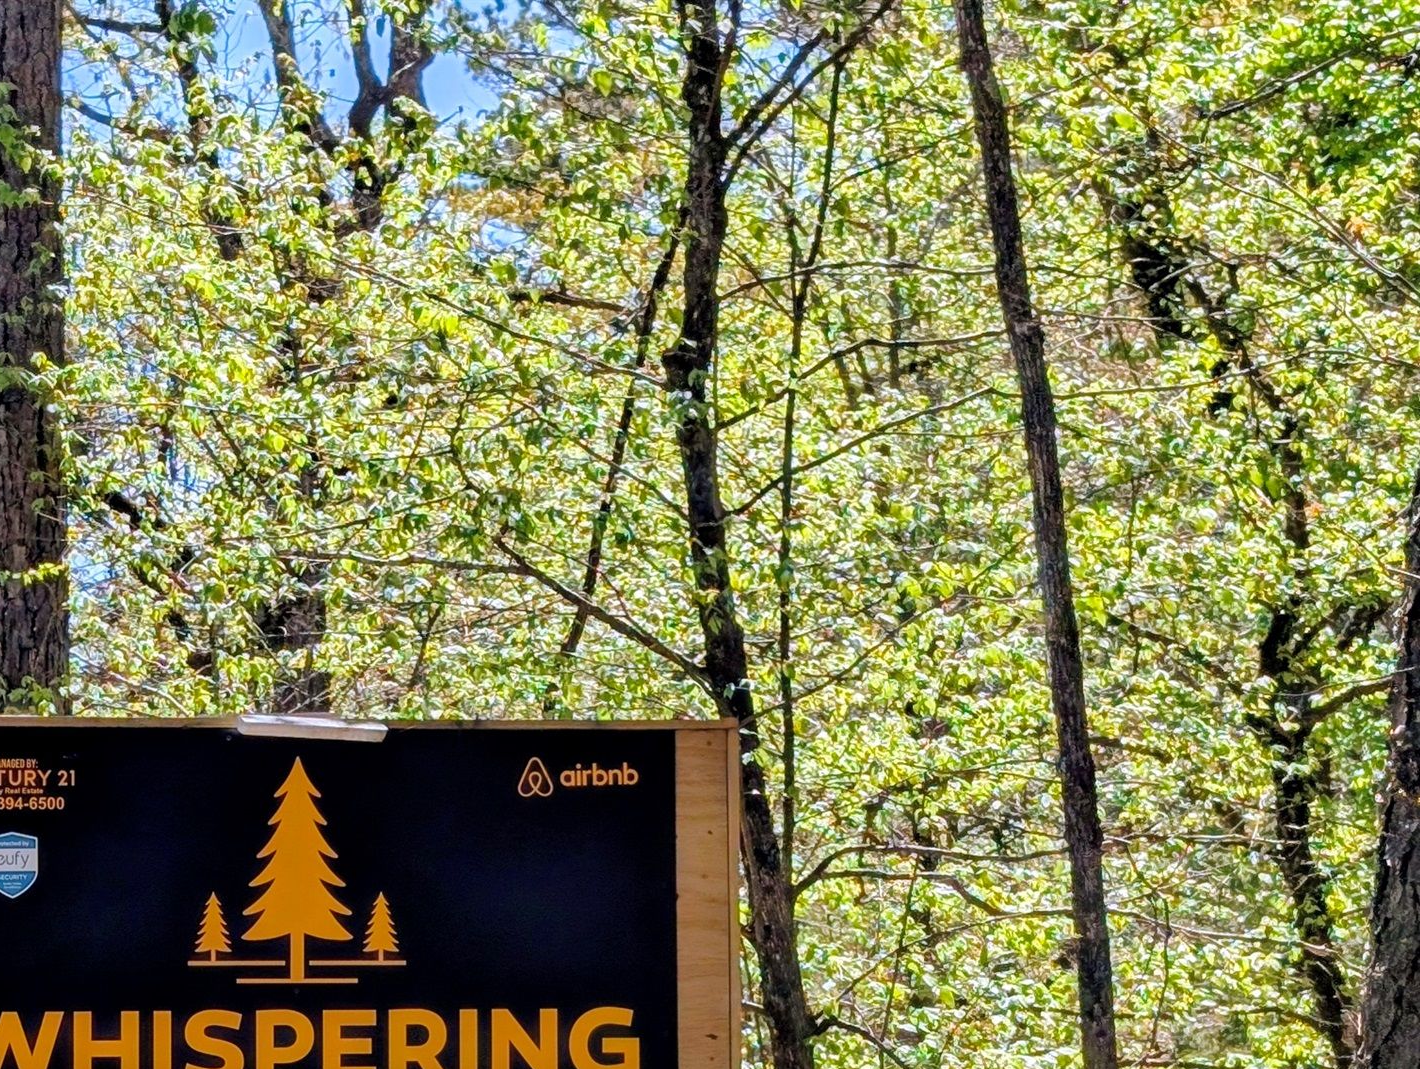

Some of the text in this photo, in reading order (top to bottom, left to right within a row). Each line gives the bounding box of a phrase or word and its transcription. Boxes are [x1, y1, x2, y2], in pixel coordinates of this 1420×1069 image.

[26, 758, 39, 769] BY:
[57, 770, 75, 786] 21
[560, 762, 639, 787] airbnb
[5, 787, 21, 795] Real
[22, 787, 44, 795] Estate
